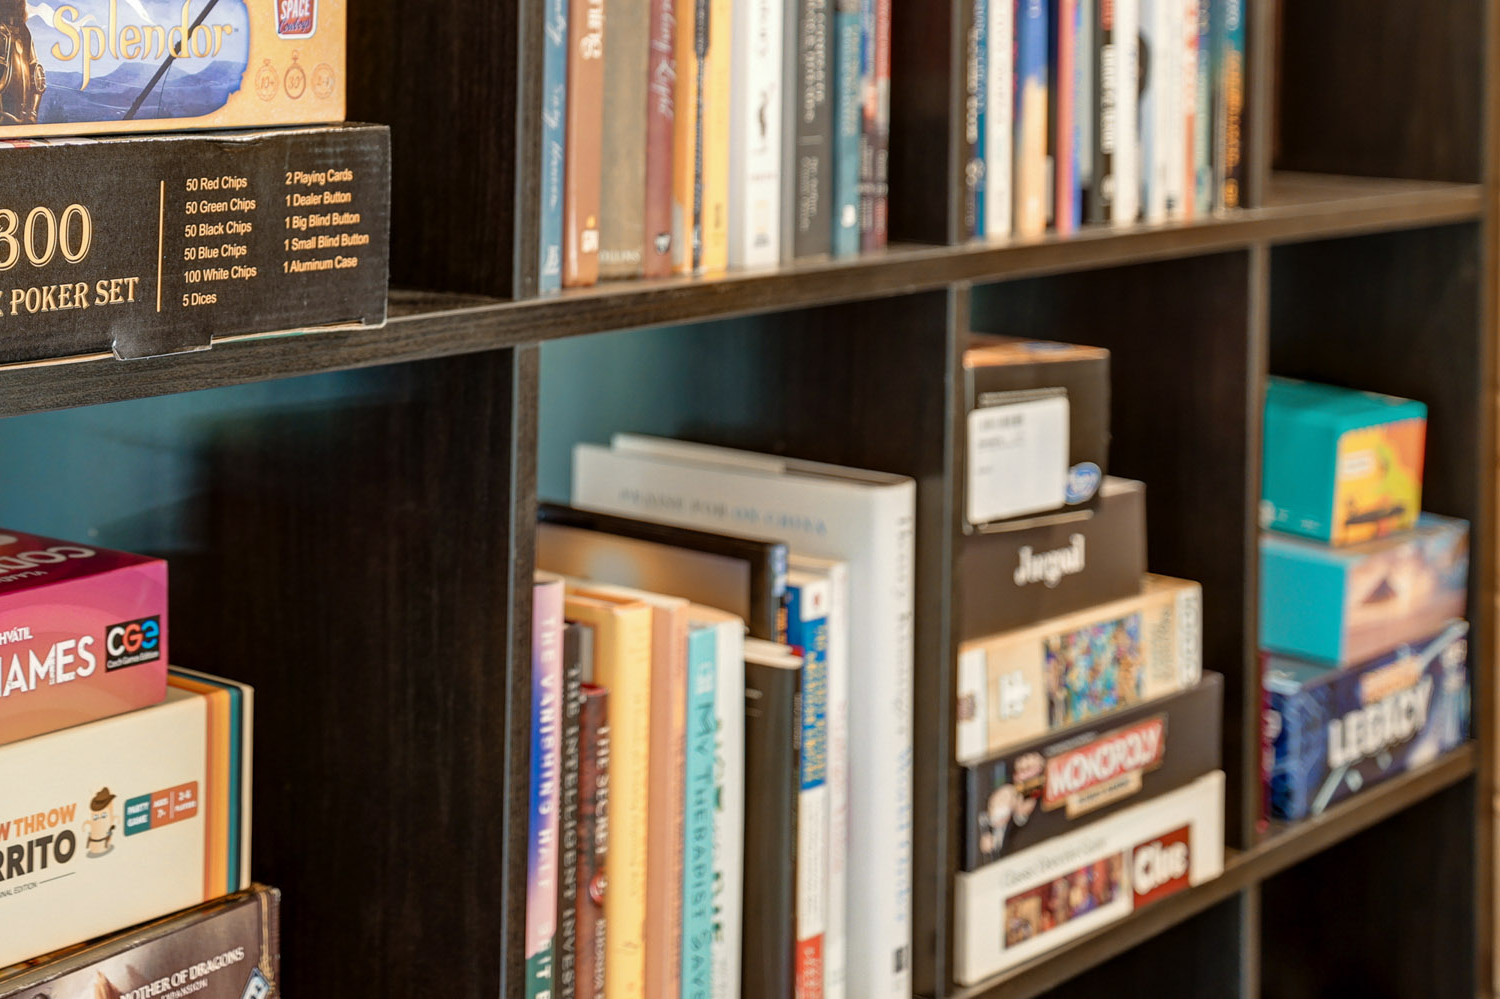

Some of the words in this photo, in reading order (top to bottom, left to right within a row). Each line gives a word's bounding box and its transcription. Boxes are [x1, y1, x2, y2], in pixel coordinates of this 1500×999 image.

[186, 178, 198, 191] 50
[201, 177, 219, 190] Red
[221, 176, 247, 191] Chips
[286, 172, 292, 185] 2
[294, 171, 325, 186] Playing
[327, 168, 353, 183] Cards
[186, 201, 197, 214] 50
[200, 200, 228, 214] Green
[230, 198, 256, 213] Chips
[286, 194, 290, 207] 1
[293, 194, 322, 207] Dealer
[323, 191, 352, 204] Button
[185, 224, 196, 237] 50
[199, 222, 224, 236] Black
[226, 221, 252, 235] Chips
[285, 217, 289, 229] 1
[292, 216, 307, 231] Big
[309, 214, 330, 227] Blind
[332, 212, 360, 225] Button
[285, 239, 289, 251] 1
[291, 237, 316, 251] Small
[318, 235, 339, 249] Blind
[341, 233, 369, 246] Button
[184, 248, 196, 261] 50
[198, 246, 218, 259] Blue
[221, 243, 247, 258] Chips
[284, 262, 288, 273] 1
[290, 258, 333, 273] Aluminum
[335, 255, 358, 269] Case
[184, 271, 200, 283] 100
[203, 268, 229, 282] White
[231, 265, 257, 280] Chips
[10, 281, 88, 316] POKER
[95, 275, 139, 306] SET
[183, 294, 189, 307] 5
[191, 292, 217, 306] Dices
[540, 616, 557, 664] THE
[566, 664, 581, 719] THE
[1328, 685, 1434, 769] LEGACY
[538, 674, 556, 816] VANISHING
[1049, 722, 1162, 797] MONOPOLY
[13, 802, 77, 838] THROW
[562, 725, 580, 900] INTELLIGENT
[1133, 840, 1189, 895] Clue
[14, 881, 38, 895] EDITION
[171, 969, 187, 985] OF
[189, 947, 244, 979] DRAGONS
